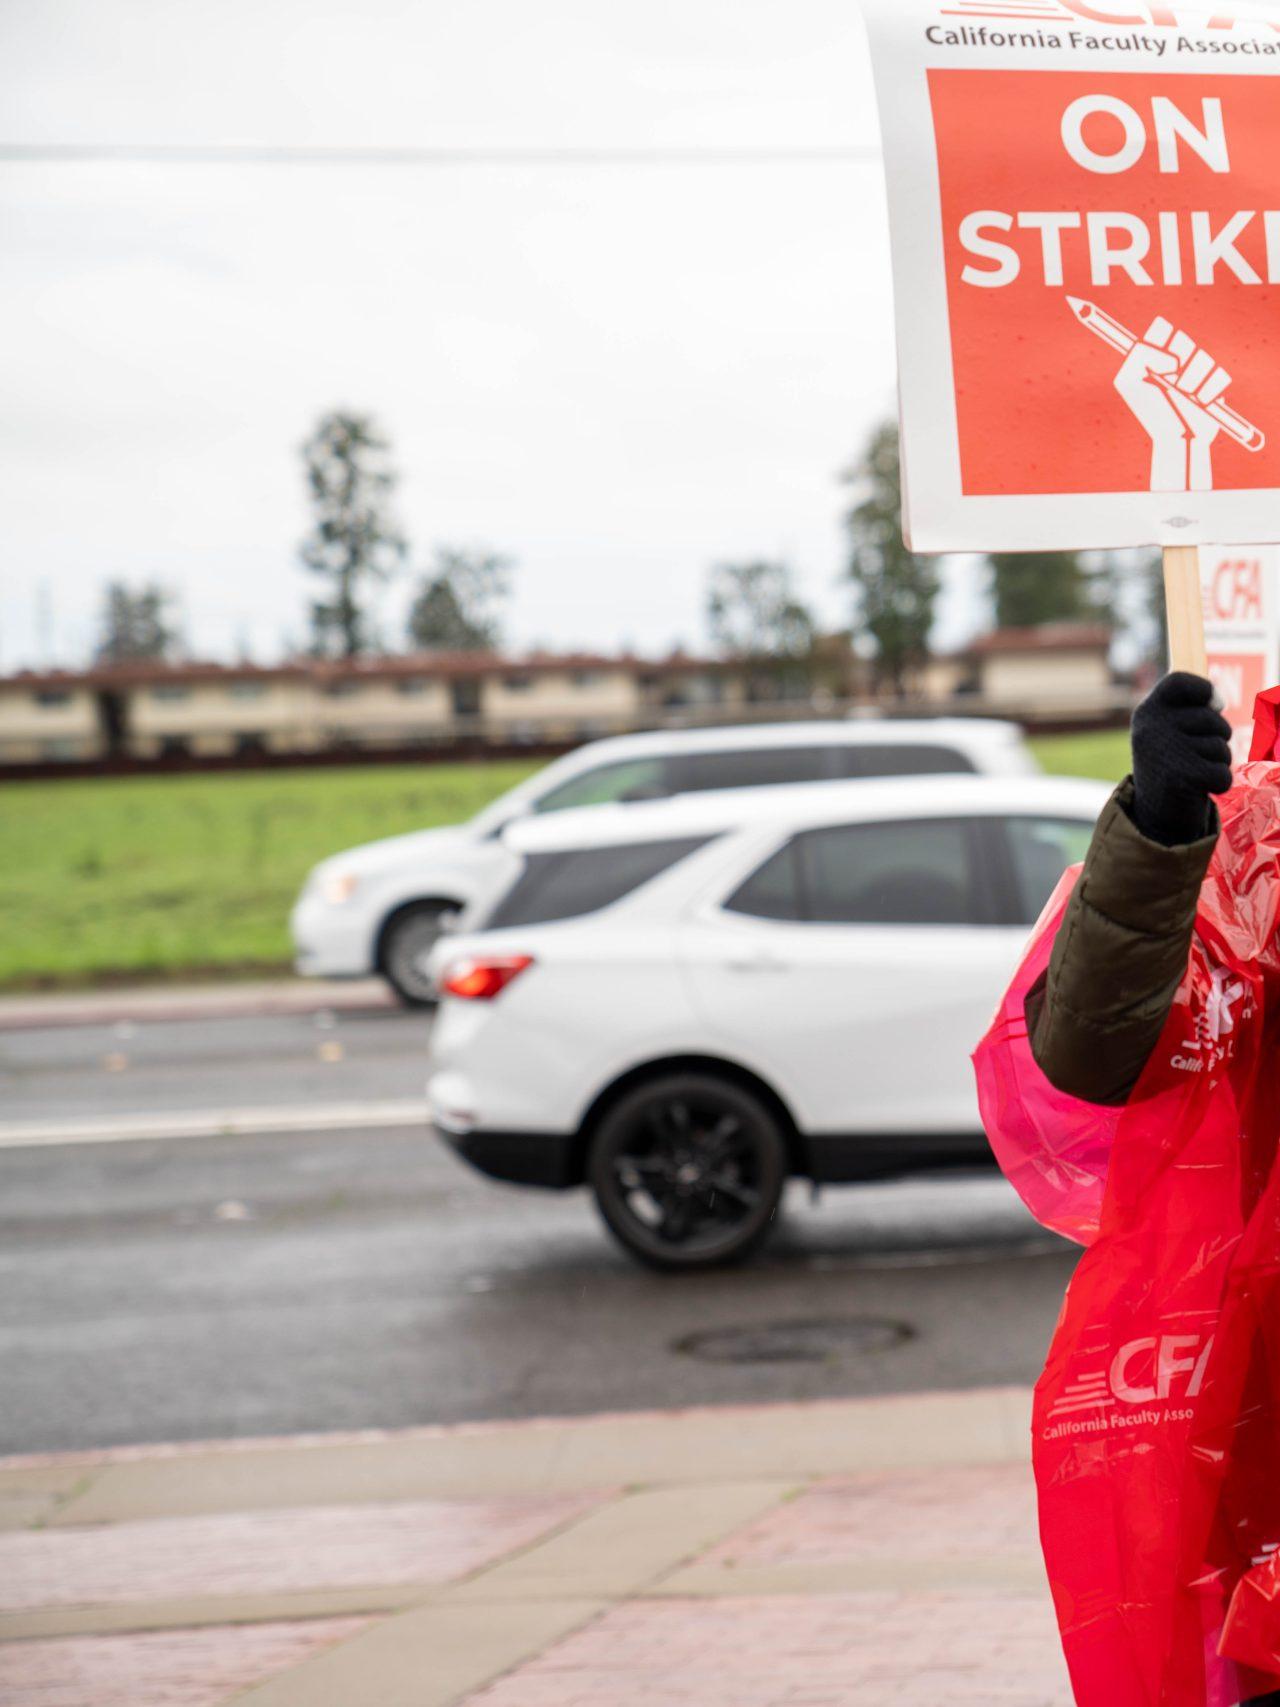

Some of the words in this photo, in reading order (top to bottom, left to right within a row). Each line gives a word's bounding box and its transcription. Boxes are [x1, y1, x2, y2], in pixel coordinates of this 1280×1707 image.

[925, 25, 1062, 50] California
[1068, 31, 1167, 57] Faculty
[1060, 94, 1230, 174] ON
[1211, 559, 1264, 622] CFA
[1042, 1417, 1108, 1441] California
[1110, 1409, 1161, 1429] Faculty
